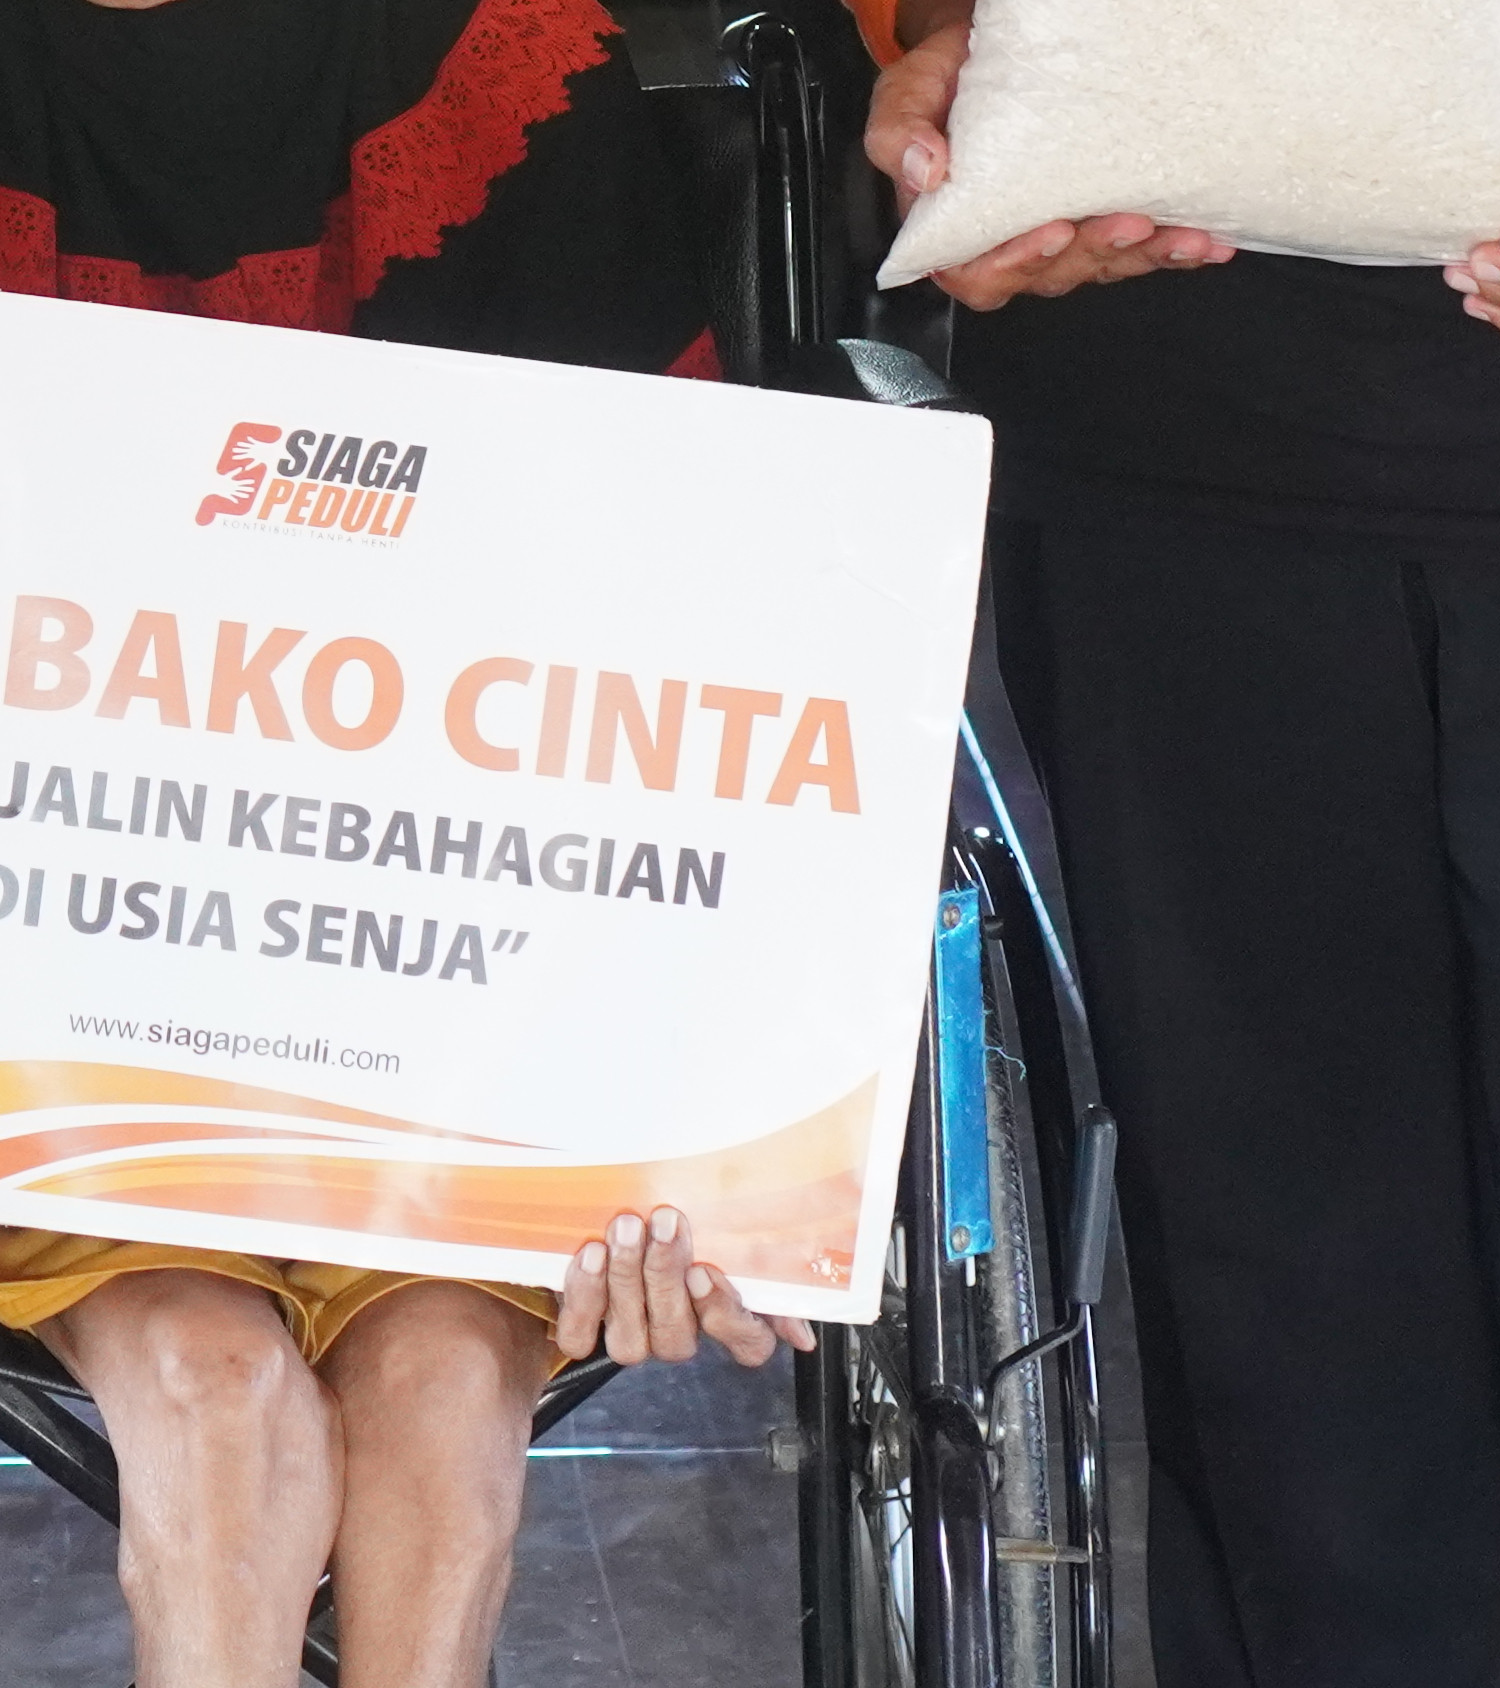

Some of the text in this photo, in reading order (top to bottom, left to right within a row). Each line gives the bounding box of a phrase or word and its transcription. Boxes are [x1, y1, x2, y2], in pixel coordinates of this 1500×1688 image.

[277, 429, 428, 493] SIAGA
[223, 519, 303, 537] KONTRIBUSI
[257, 478, 416, 538] PEDULI
[443, 656, 862, 814] CINTA
[227, 790, 726, 909] KEBAHAGIAN
[66, 874, 238, 954] USIA
[69, 1013, 400, 1074] www.siagapeduli.com
